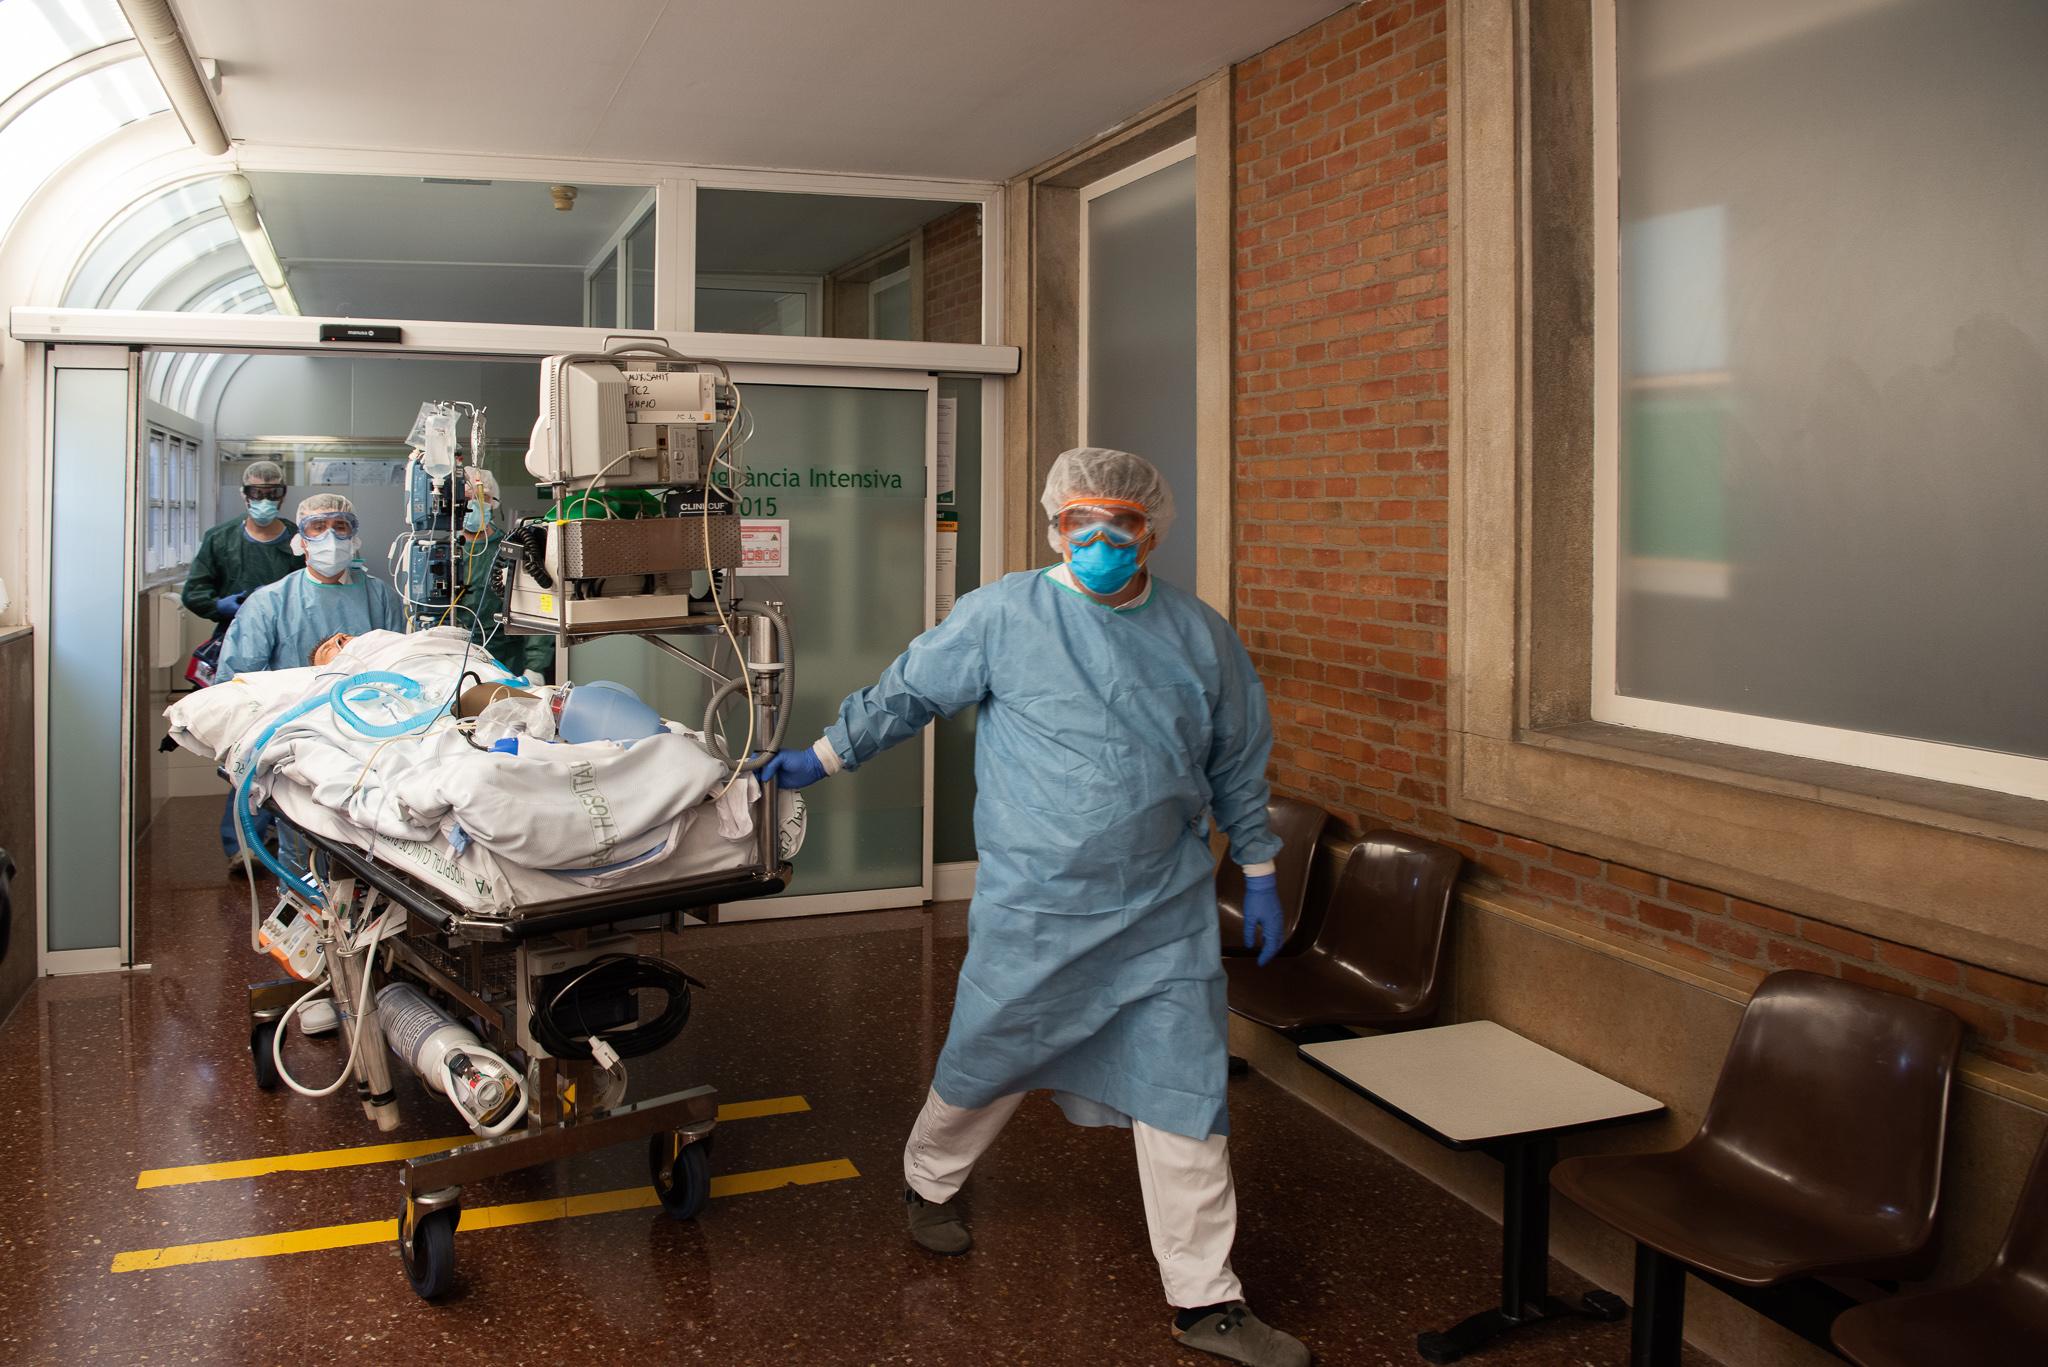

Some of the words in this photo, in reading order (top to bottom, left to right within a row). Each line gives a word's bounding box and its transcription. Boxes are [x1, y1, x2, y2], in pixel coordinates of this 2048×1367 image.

[809, 467, 903, 489] Intensiva
[739, 496, 777, 517] 015
[570, 761, 614, 829] HOSPITAL
[431, 853, 466, 888] HOSPITAL
